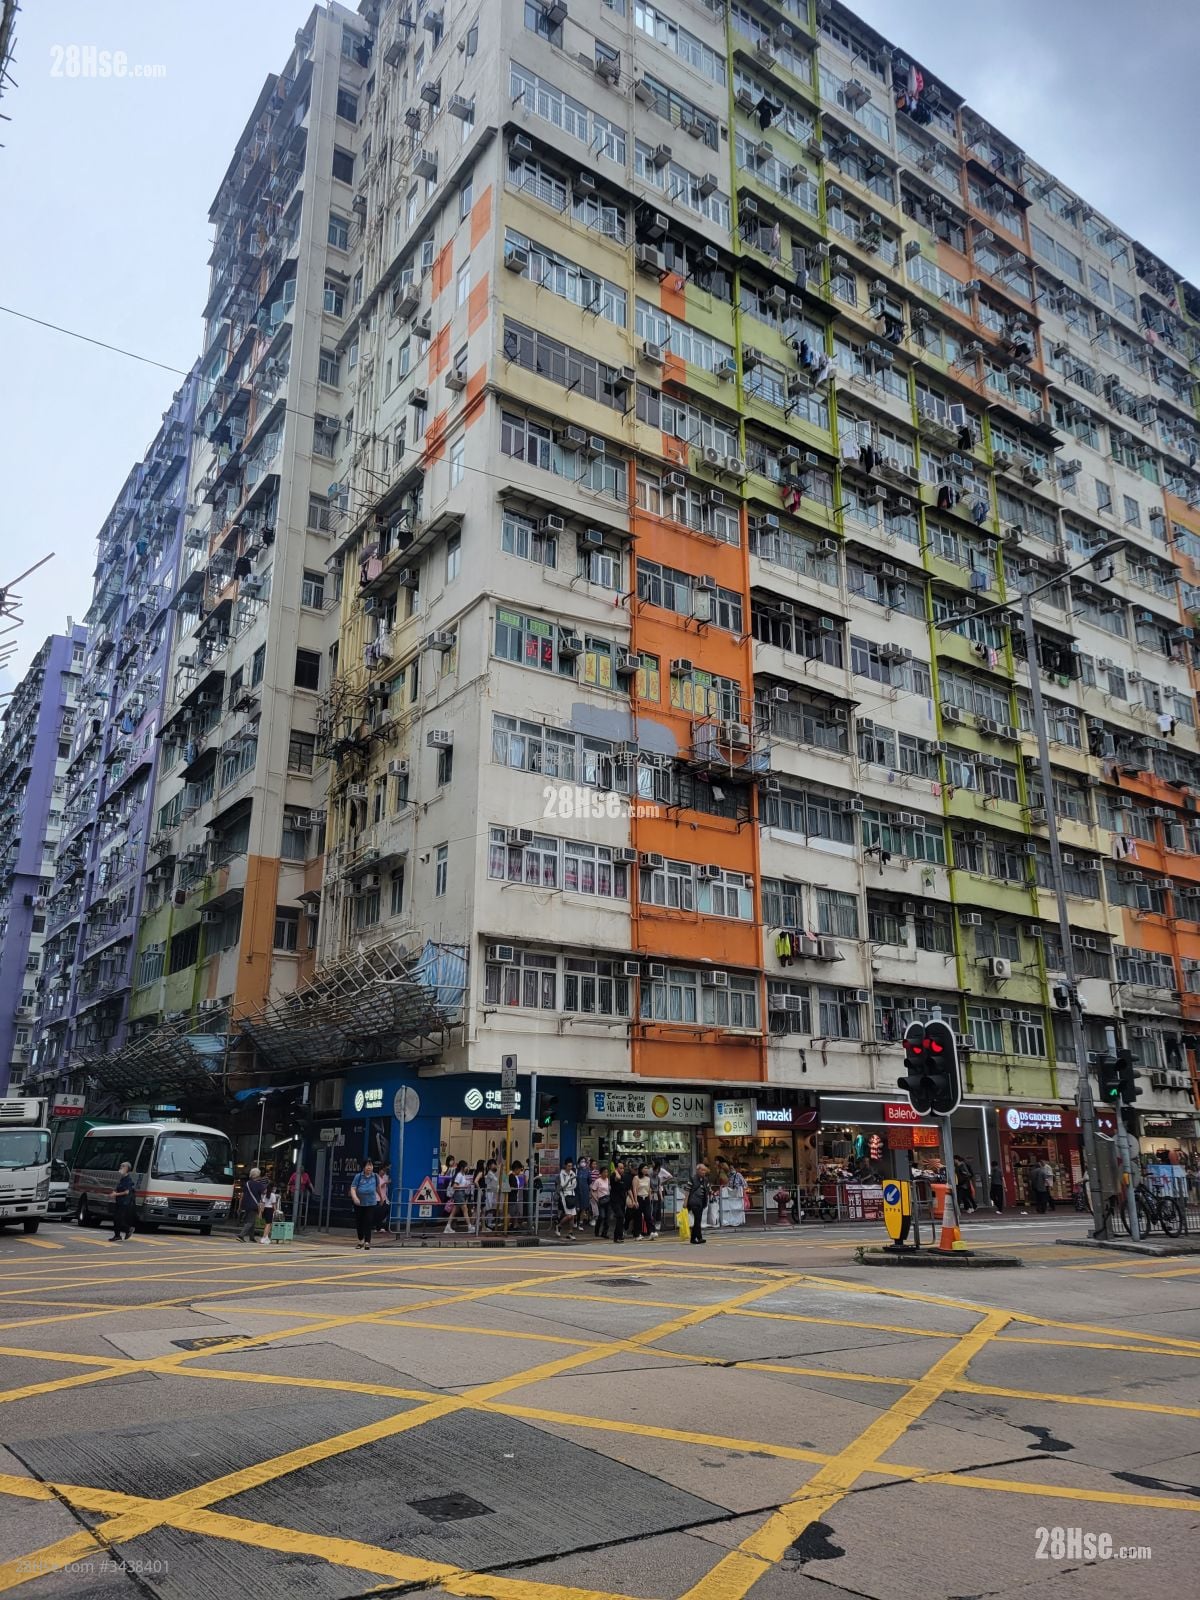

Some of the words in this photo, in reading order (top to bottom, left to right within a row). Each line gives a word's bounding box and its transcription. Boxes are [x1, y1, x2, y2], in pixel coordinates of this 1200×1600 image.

[628, 1092, 646, 1102] Digital
[606, 1101, 646, 1114] 電訊數碼
[672, 1097, 704, 1111] SUN
[756, 1108, 793, 1122] mazaki
[888, 1107, 917, 1120] Baleno
[1029, 1112, 1062, 1122] GROCERIES
[733, 1121, 748, 1129] SUN
[913, 1134, 936, 1144] SALE
